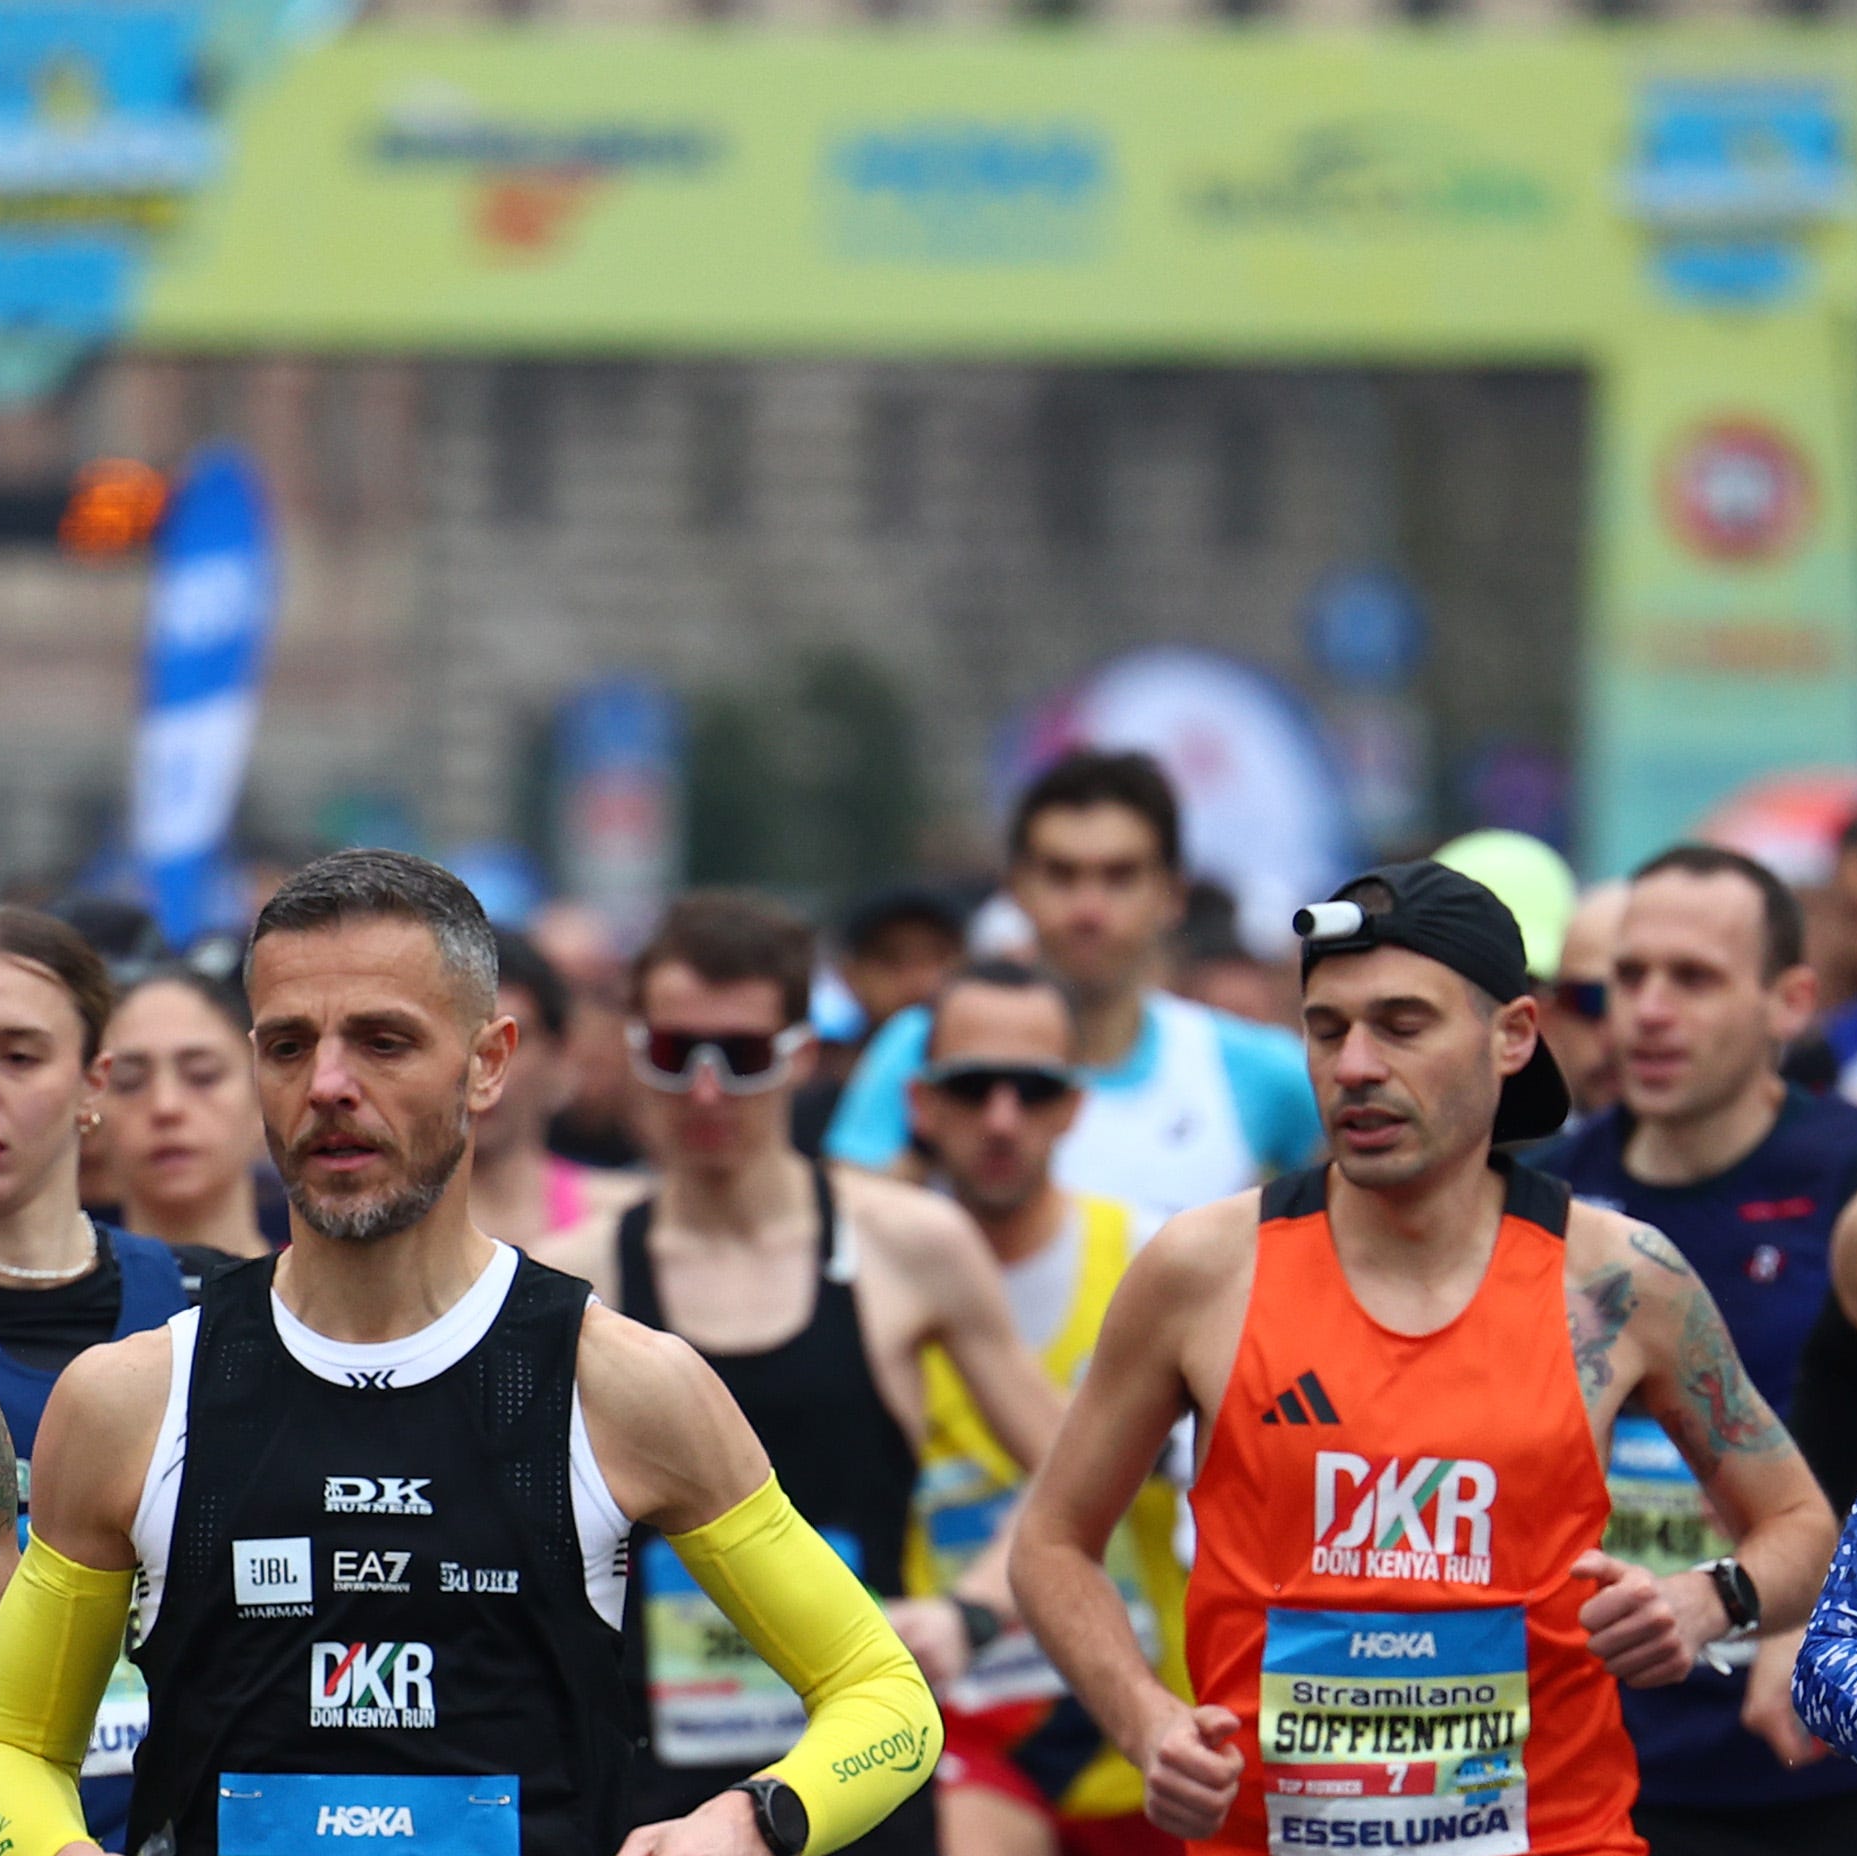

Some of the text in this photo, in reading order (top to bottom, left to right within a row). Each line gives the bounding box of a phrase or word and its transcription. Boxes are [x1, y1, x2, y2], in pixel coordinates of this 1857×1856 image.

[325, 1502, 434, 1516] RUNNERS
[1313, 1451, 1499, 1556] DKR
[251, 1557, 298, 1586] JBL
[333, 1551, 412, 1583] EA7
[1311, 1546, 1492, 1585] DON KENYA RUN
[247, 1604, 314, 1618] HARMAN
[1350, 1631, 1436, 1659] HOKA
[311, 1641, 435, 1709] DKR
[1292, 1681, 1496, 1708] Stramilano
[310, 1708, 435, 1728] DON KENYA RUN
[1275, 1711, 1518, 1754] SOFFIENTINI
[831, 1727, 917, 1783] saucony
[1386, 1763, 1409, 1794] 7
[316, 1805, 415, 1837] HOKA
[1281, 1808, 1510, 1848] ESSELUNGA
